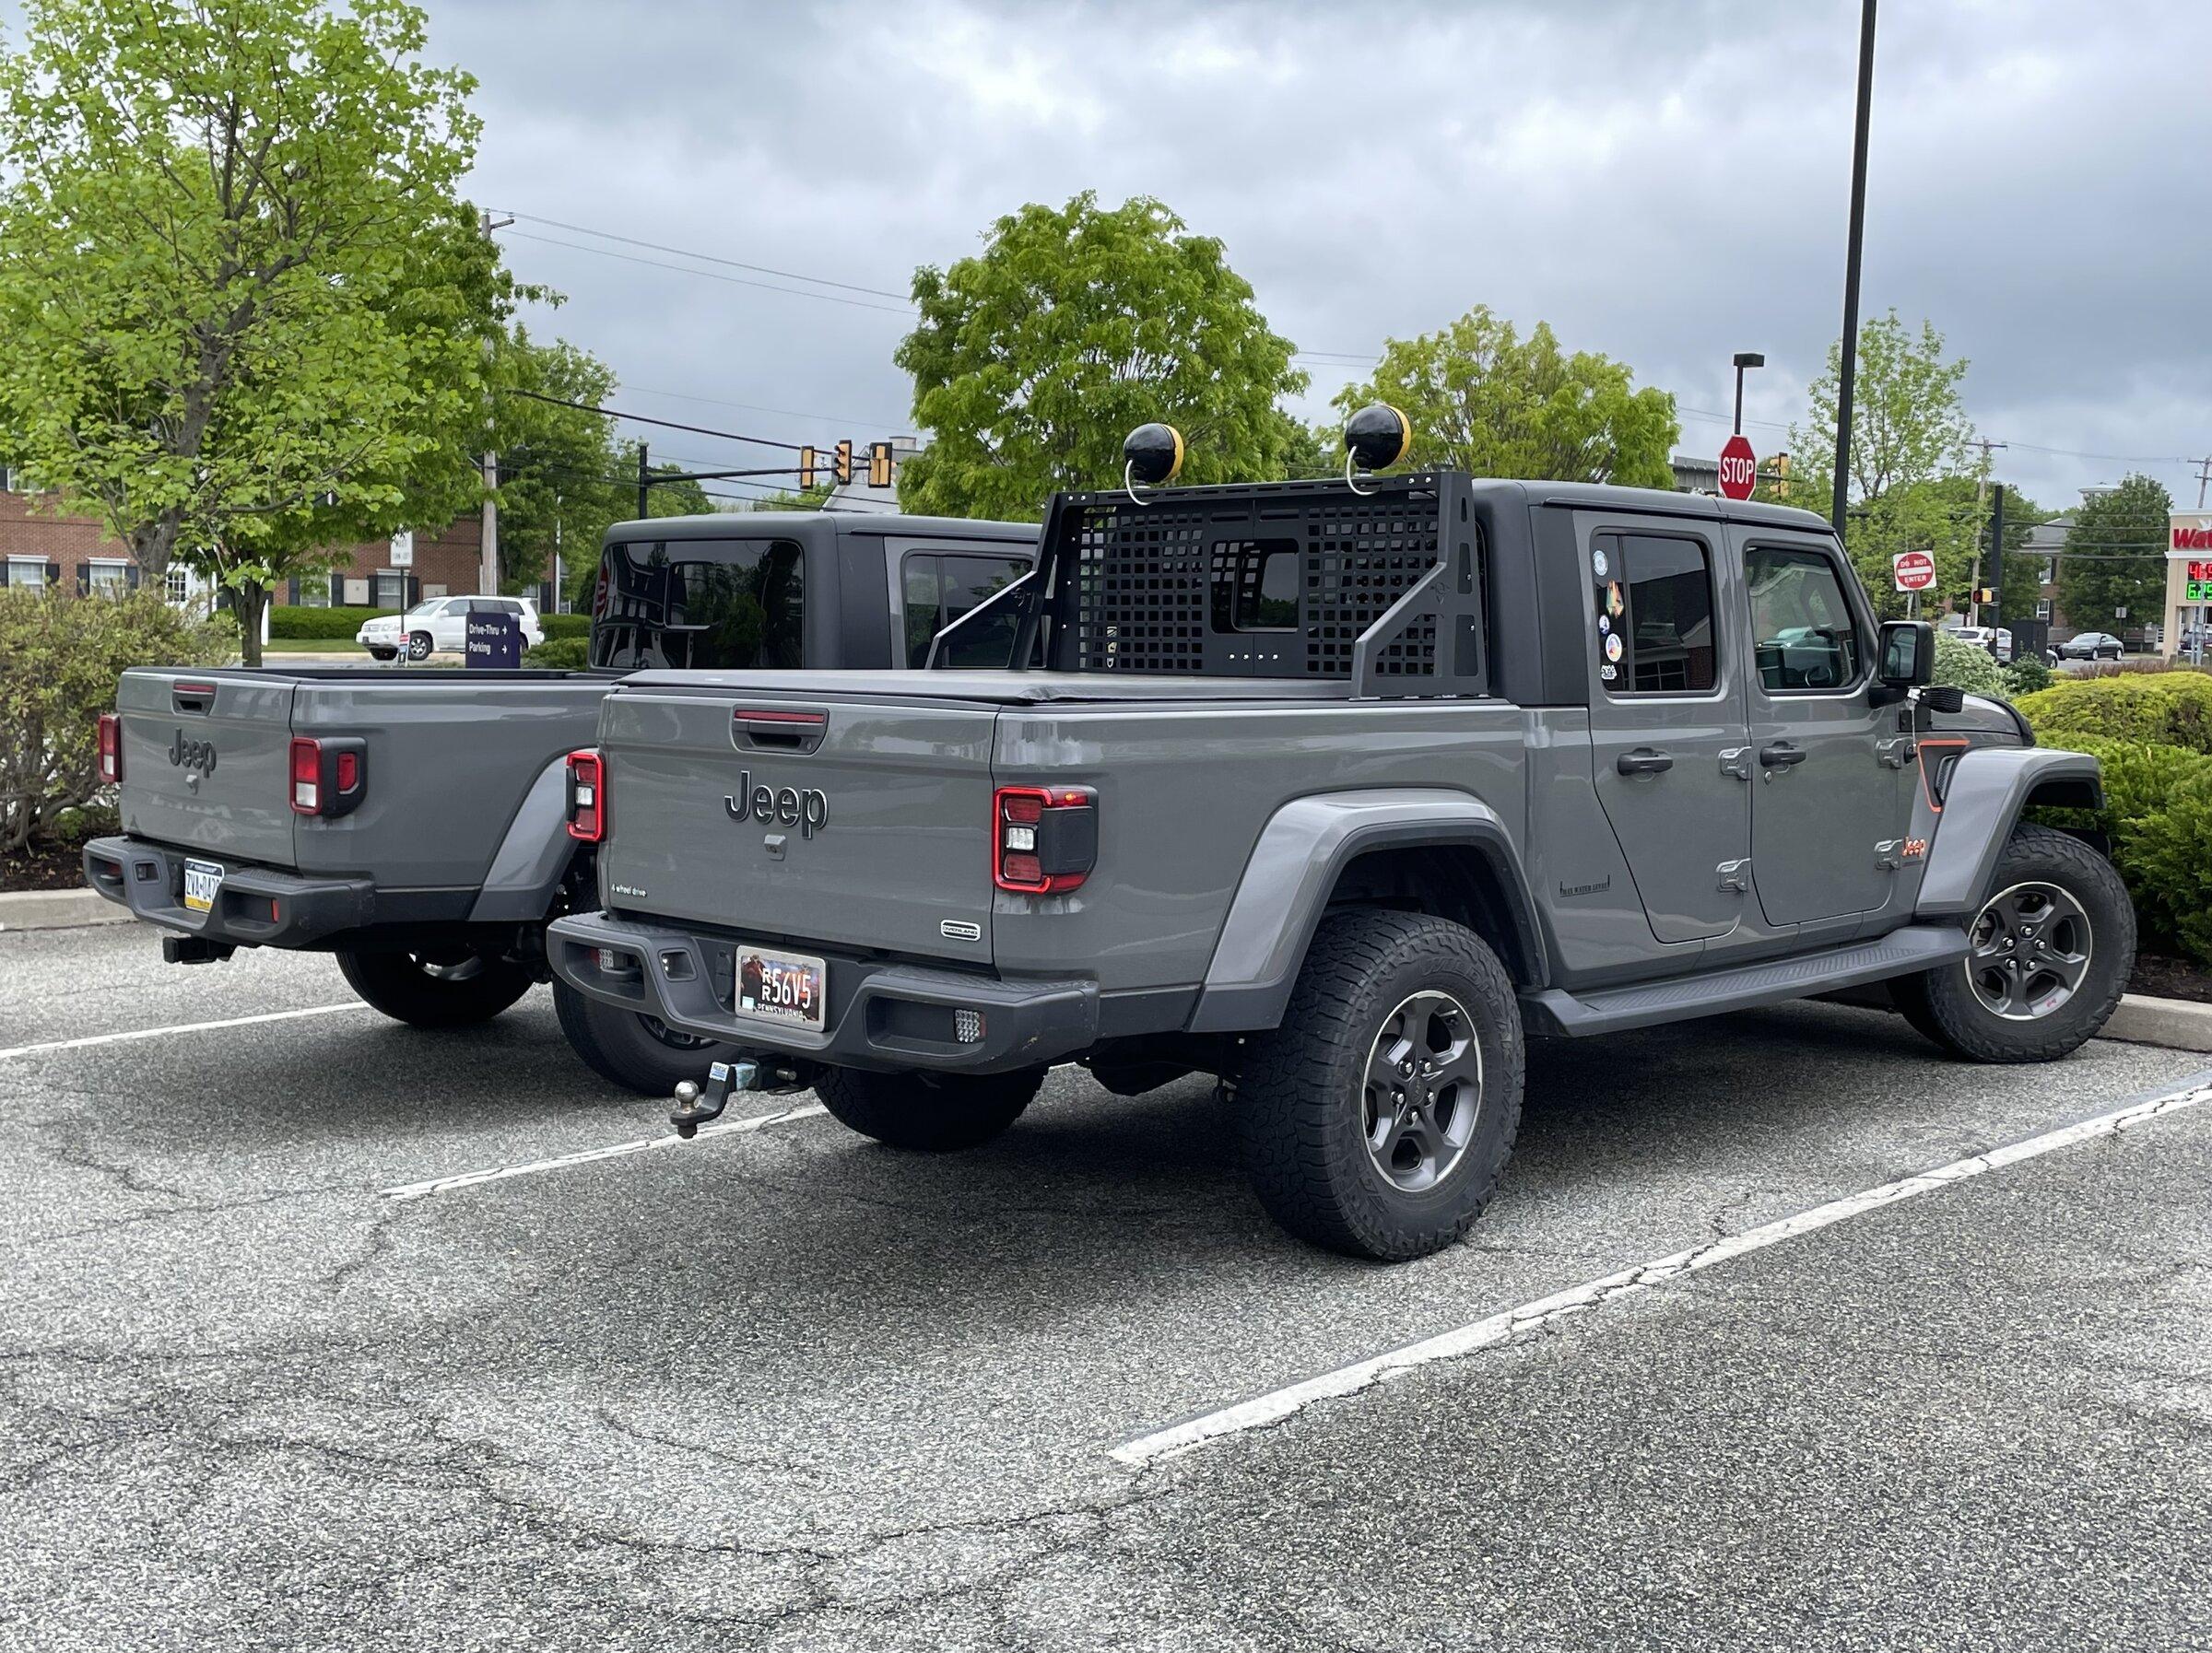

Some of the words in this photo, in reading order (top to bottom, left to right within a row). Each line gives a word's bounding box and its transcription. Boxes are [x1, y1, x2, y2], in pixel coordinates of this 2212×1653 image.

[1721, 456, 1754, 485] STOP
[1913, 558, 1927, 567] NOT
[1904, 575, 1927, 583] ENTER
[469, 624, 500, 636] Drive-Thru
[469, 641, 491, 655] Parking
[169, 727, 217, 779] Jeep
[724, 769, 829, 840] Jeep
[1901, 836, 1925, 858] Jeep
